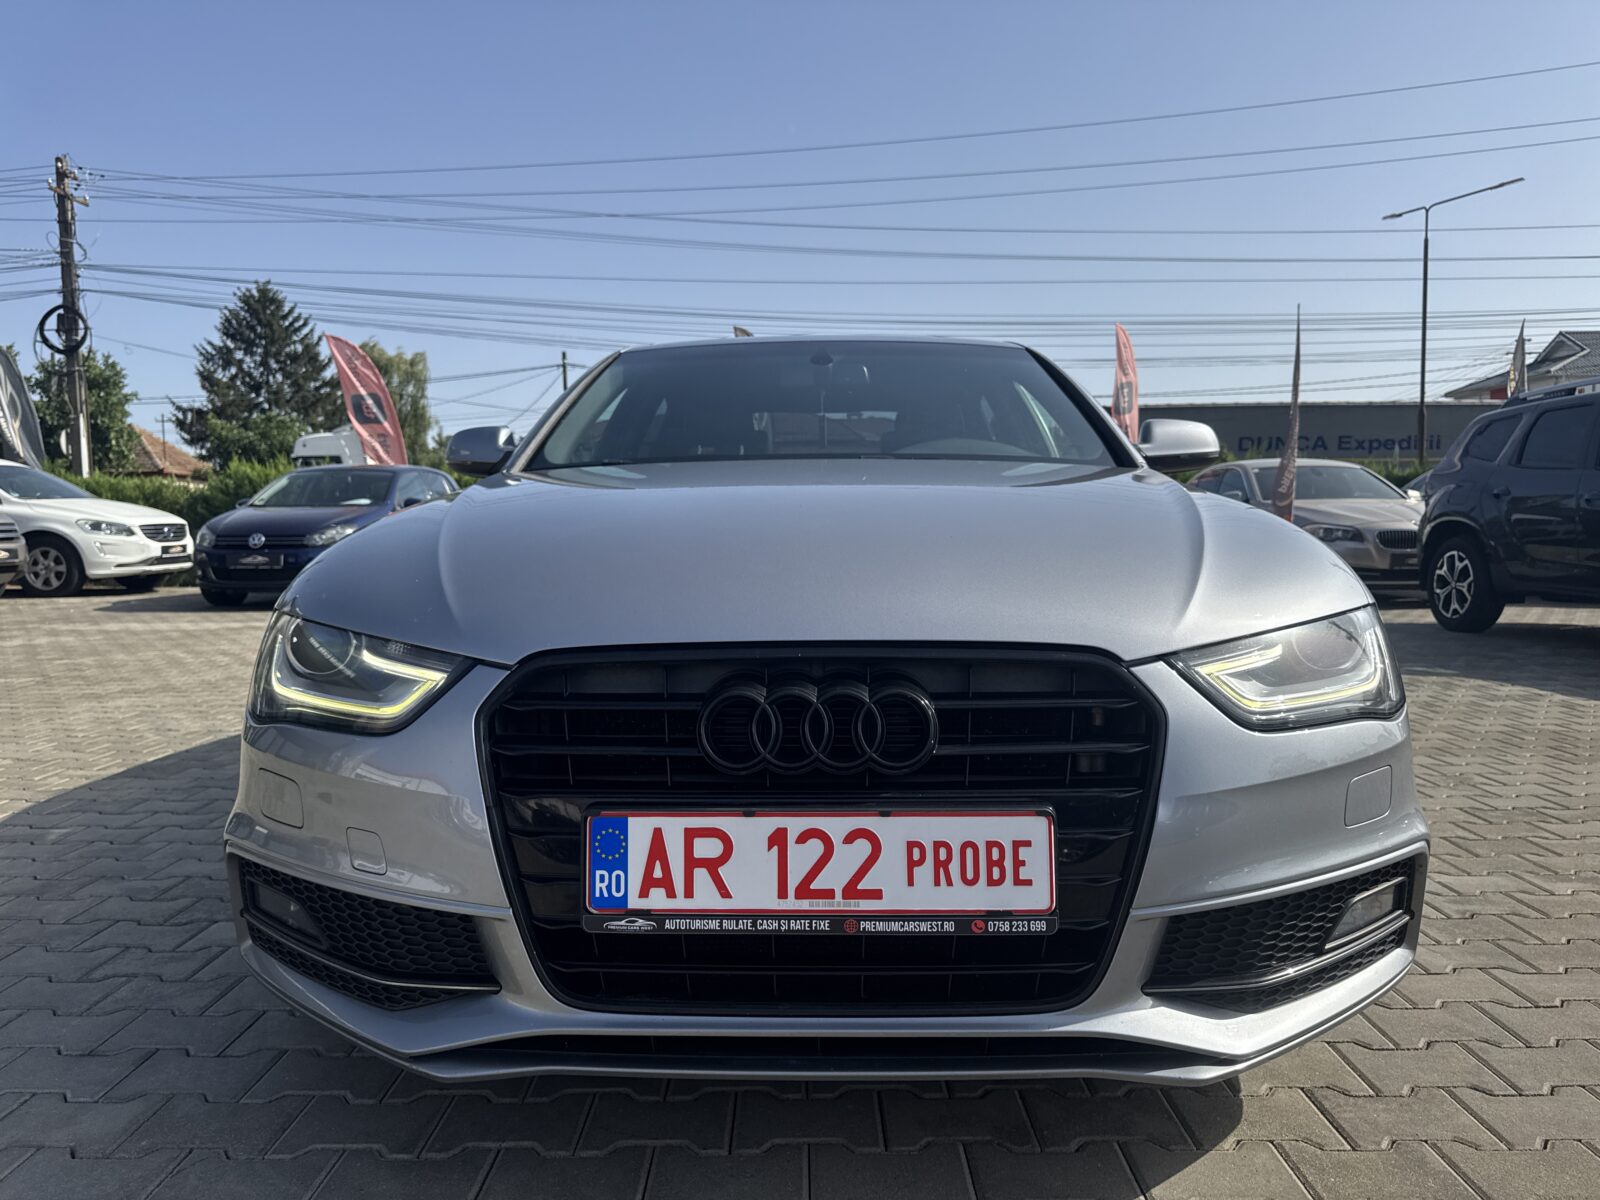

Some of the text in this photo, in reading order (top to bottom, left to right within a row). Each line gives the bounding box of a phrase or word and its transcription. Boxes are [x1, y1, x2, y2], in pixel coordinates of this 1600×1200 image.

[1238, 434, 1440, 453] DUNCA Expediii
[638, 827, 1033, 900] AR 122 PROBE
[595, 870, 625, 897] RO
[665, 919, 720, 930] AUTOTURISME
[722, 919, 755, 931] RULATE,
[757, 919, 779, 930] CASH
[790, 919, 811, 931] RATE
[812, 919, 831, 931] FIXE
[860, 921, 955, 932] PREMIUMCARSWEST.RO
[987, 920, 1047, 932] 0758 233 699
